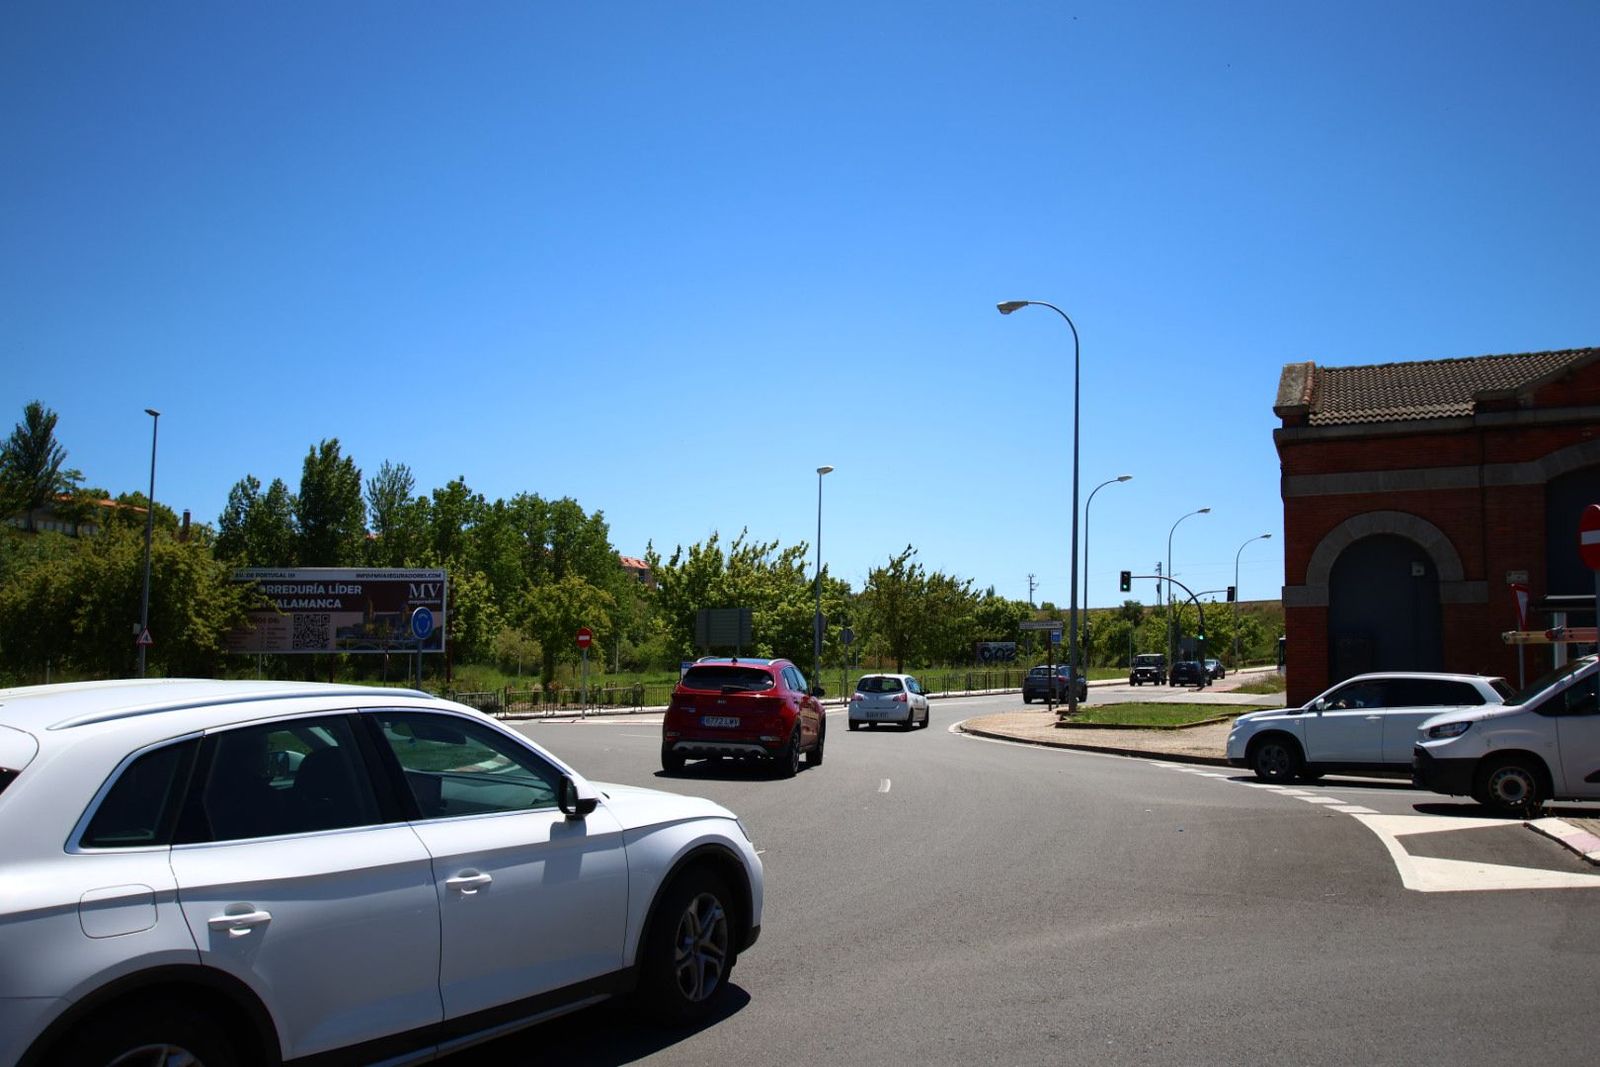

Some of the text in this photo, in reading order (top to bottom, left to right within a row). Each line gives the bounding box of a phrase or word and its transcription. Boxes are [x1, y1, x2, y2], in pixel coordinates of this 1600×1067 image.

[328, 582, 362, 594] LÍDER
[409, 583, 441, 598] MV
[271, 599, 342, 608] ALAMANCA
